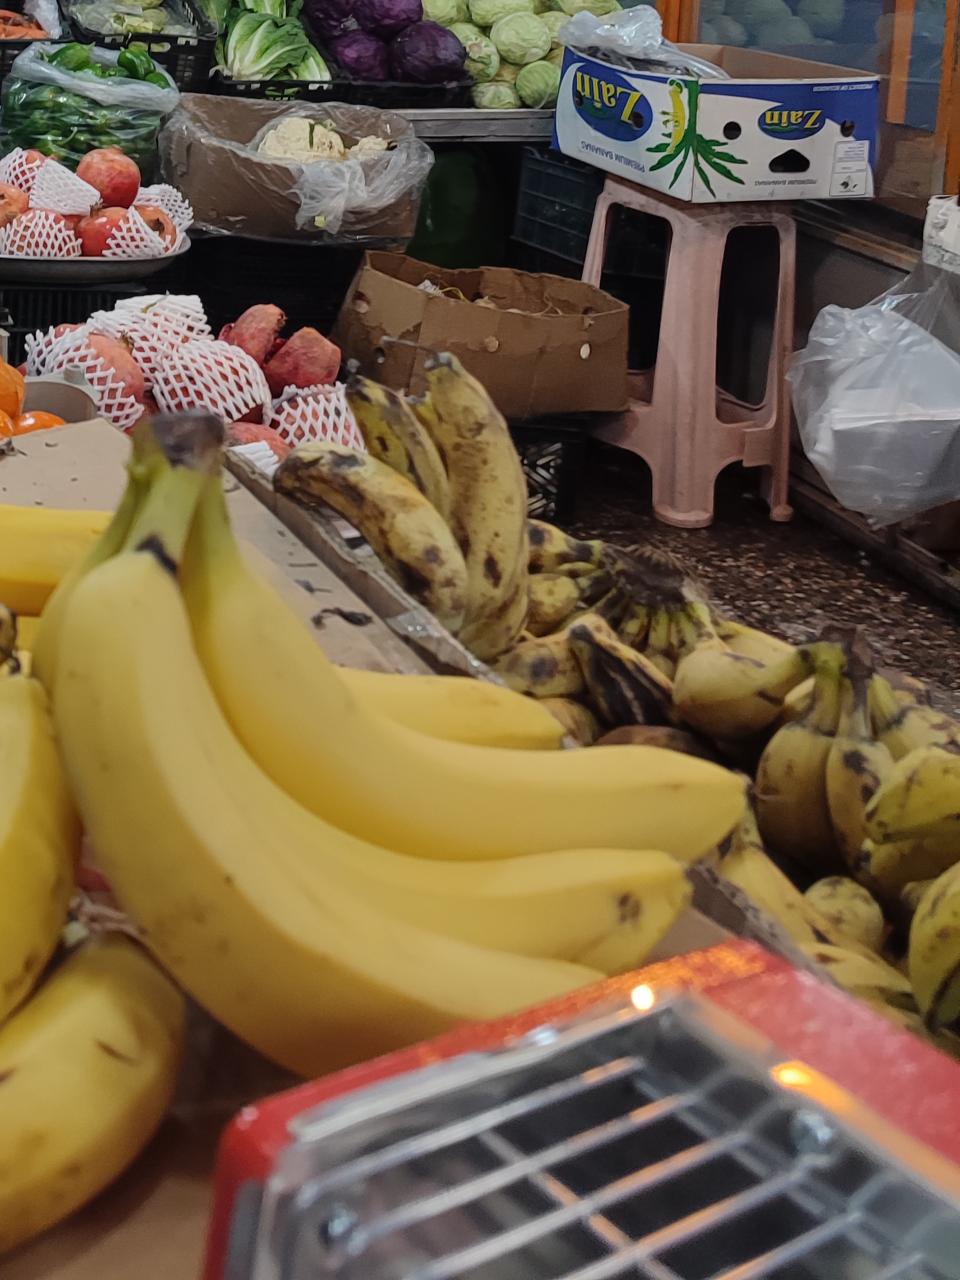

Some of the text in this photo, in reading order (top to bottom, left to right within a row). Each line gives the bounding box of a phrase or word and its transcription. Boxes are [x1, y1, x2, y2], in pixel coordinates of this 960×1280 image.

[576, 71, 641, 124] Zain
[765, 110, 821, 129] Zain
[581, 140, 646, 173] PREMIUM BANANAS
